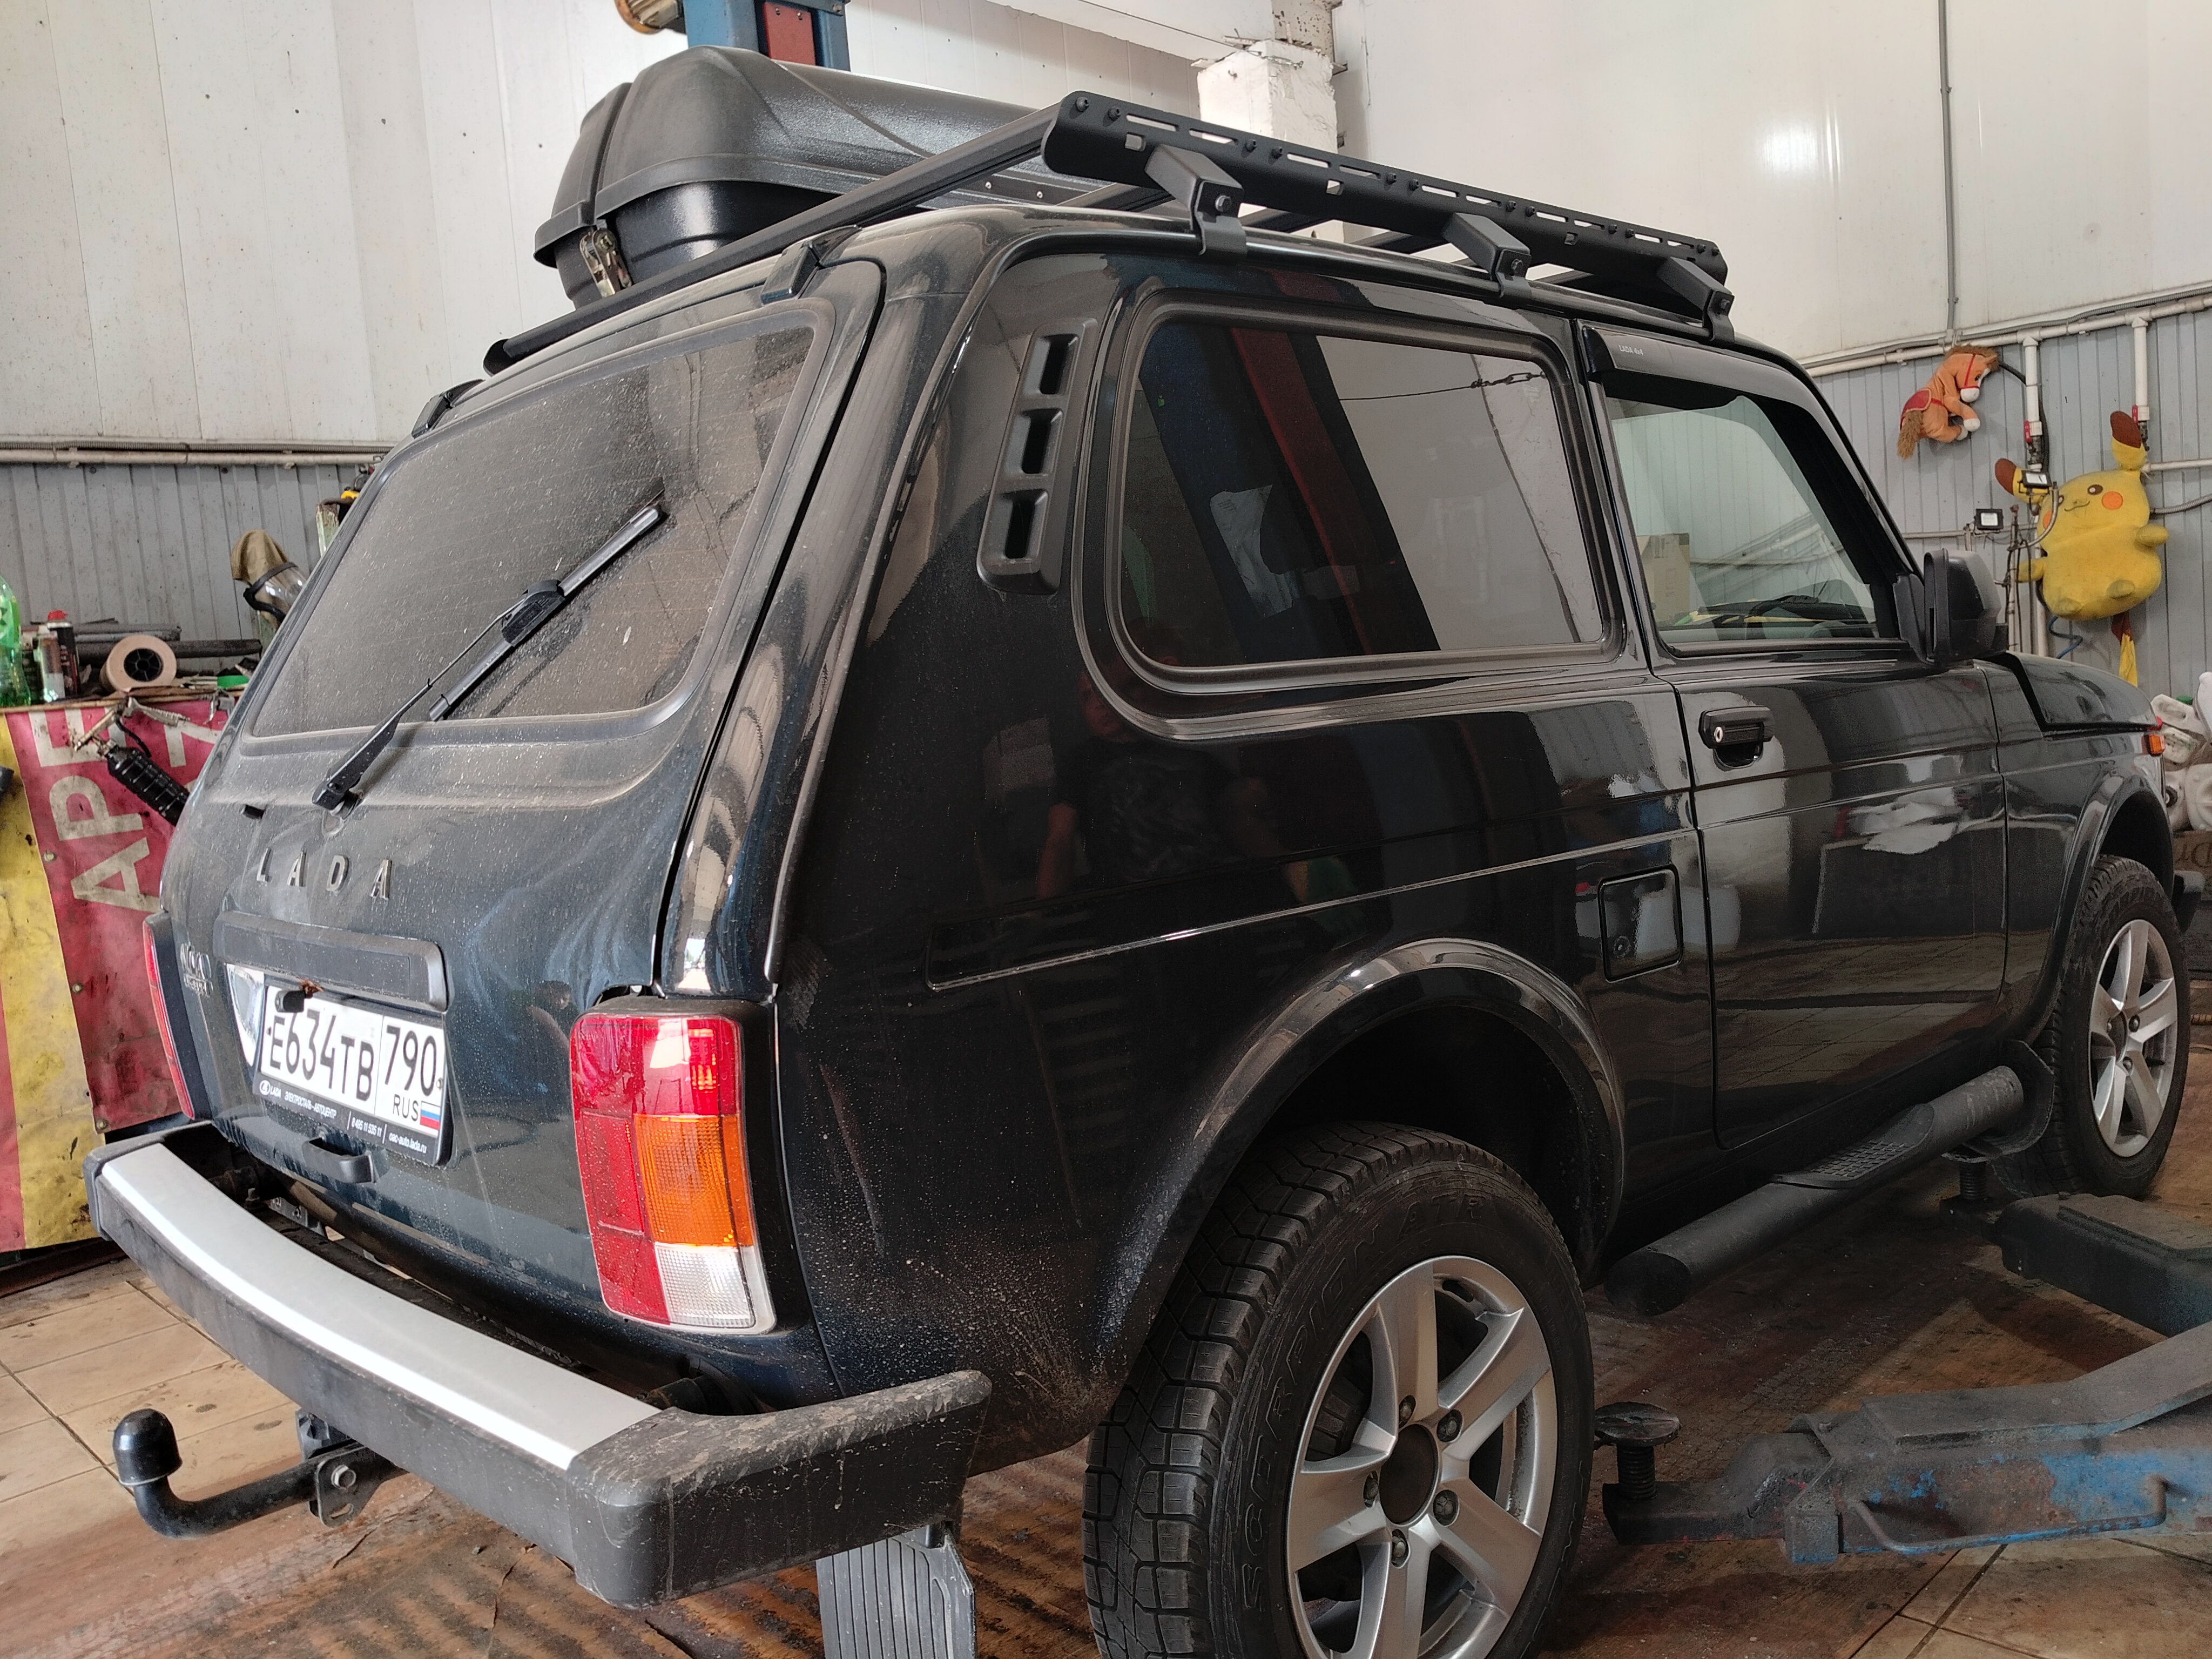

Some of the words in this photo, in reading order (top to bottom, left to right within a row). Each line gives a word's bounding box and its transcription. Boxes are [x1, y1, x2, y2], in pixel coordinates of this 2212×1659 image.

[1618, 345, 1634, 354] LADA
[256, 847, 393, 900] LADA
[385, 1024, 437, 1097] 790
[271, 1085, 281, 1098] LADA
[393, 1094, 419, 1122] RUS
[1398, 1192, 1487, 1240] ATR
